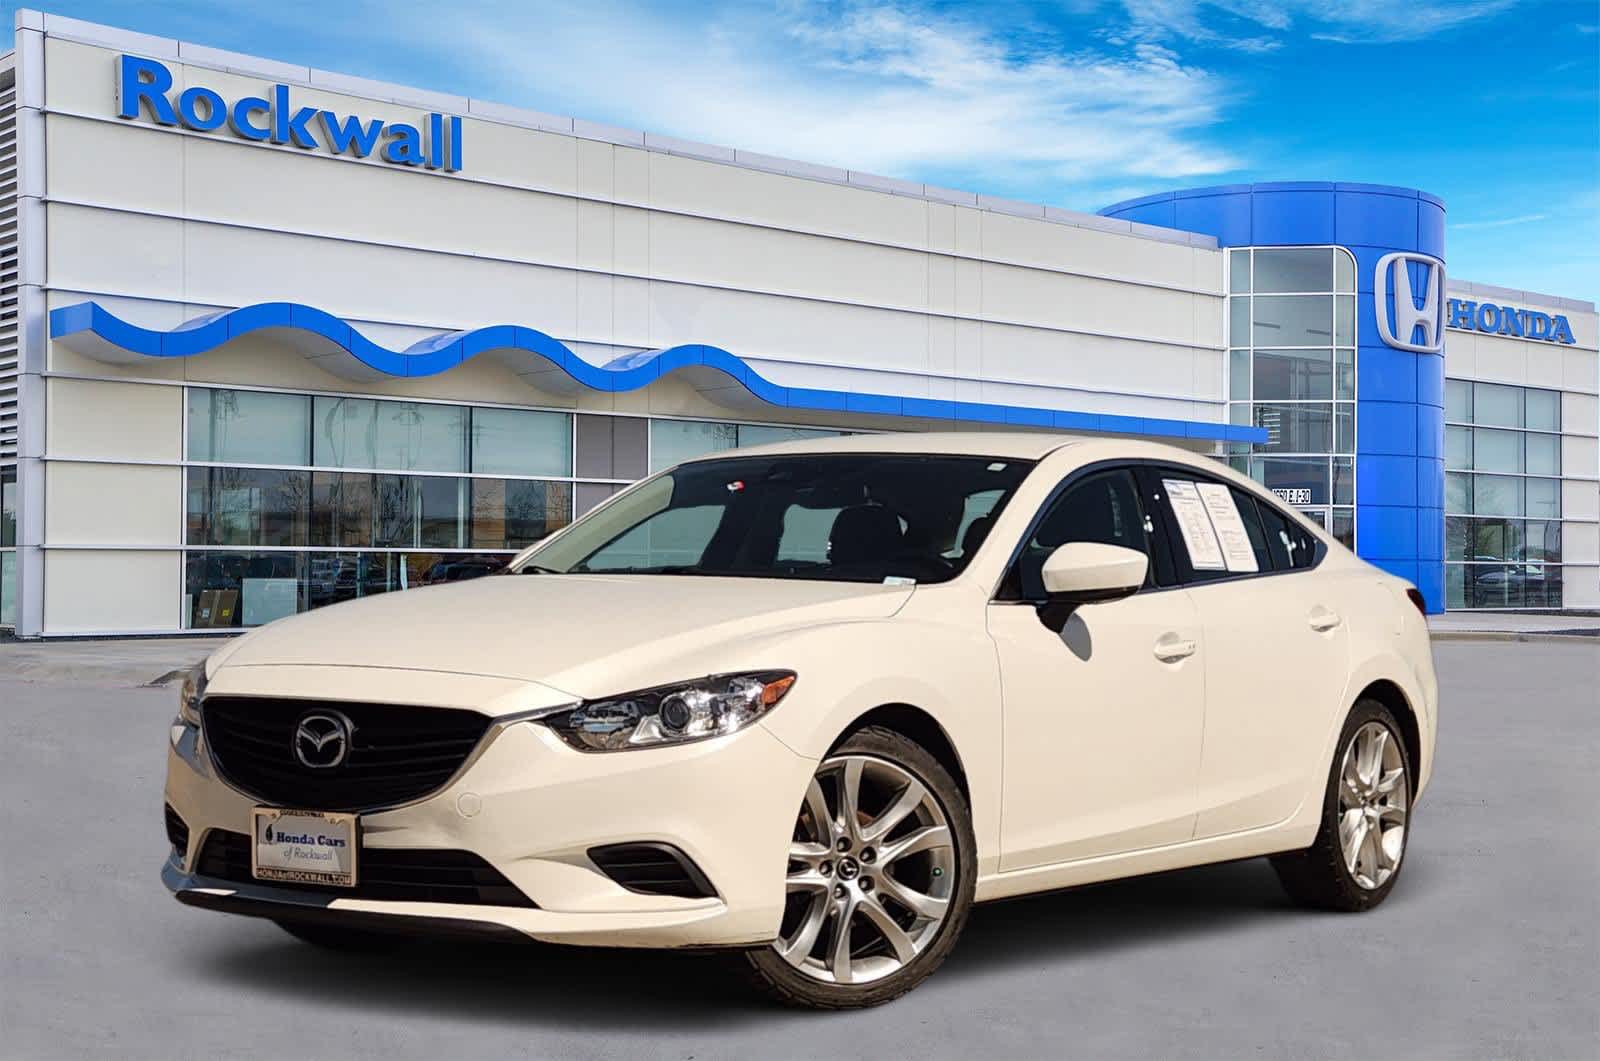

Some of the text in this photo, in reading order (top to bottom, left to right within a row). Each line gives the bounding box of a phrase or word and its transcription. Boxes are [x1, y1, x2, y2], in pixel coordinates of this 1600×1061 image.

[117, 54, 463, 172] Rockwall
[1448, 299, 1577, 344] HONDA
[1296, 490, 1310, 502] I-30
[276, 832, 346, 847] Honda Cars
[283, 847, 333, 860] of Rockwall
